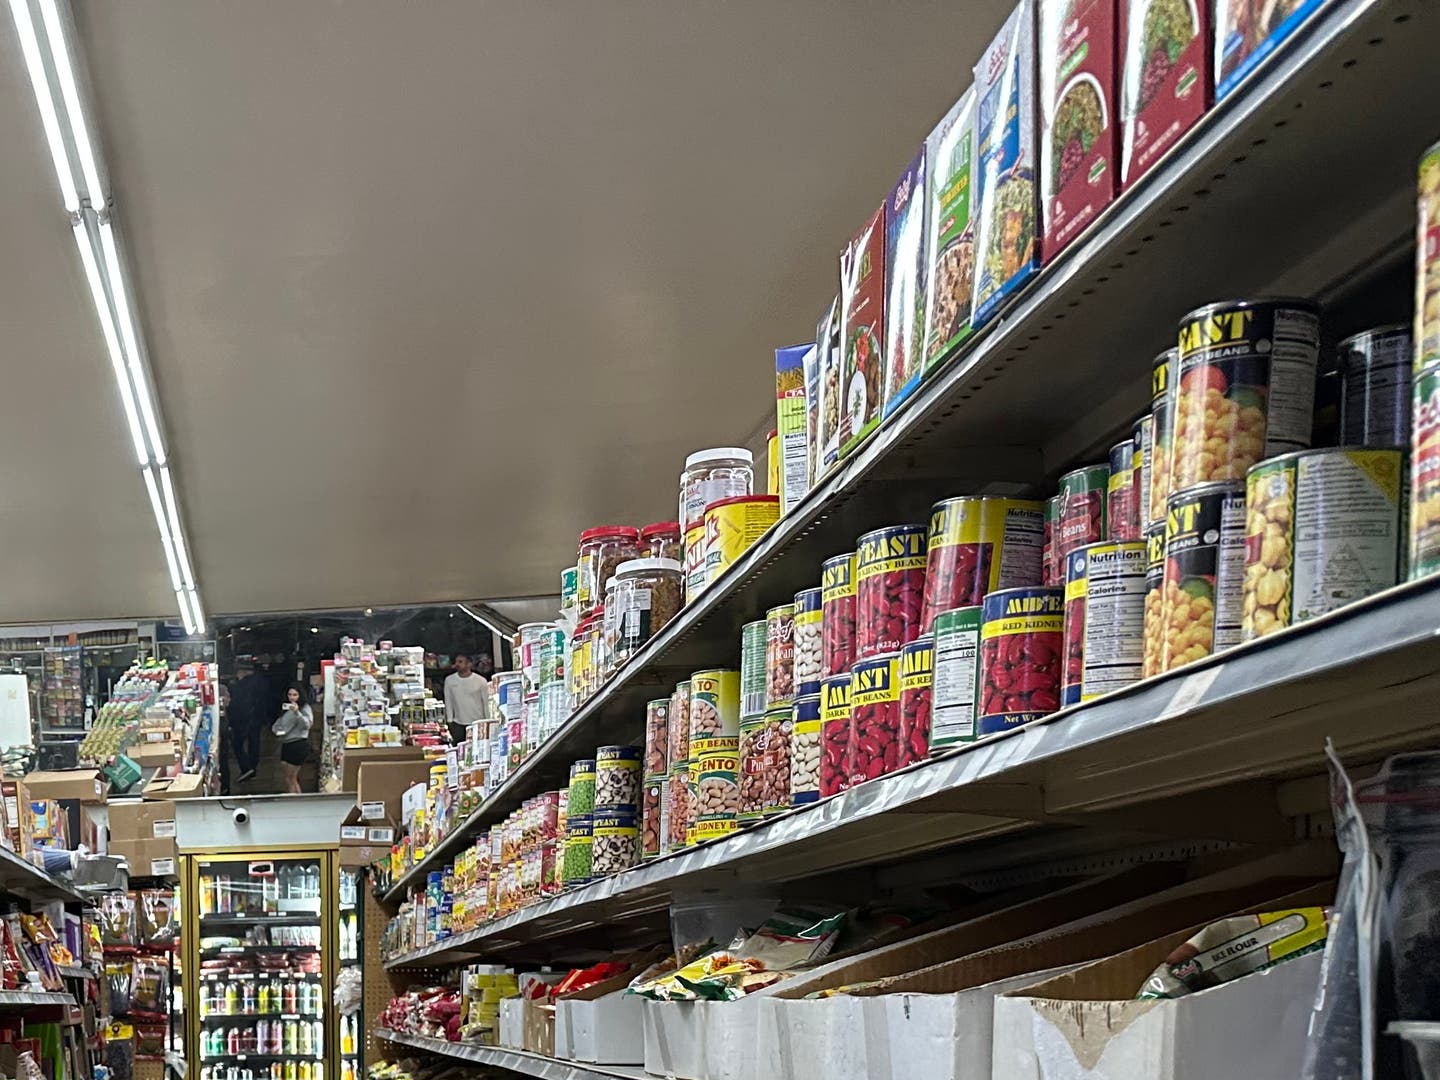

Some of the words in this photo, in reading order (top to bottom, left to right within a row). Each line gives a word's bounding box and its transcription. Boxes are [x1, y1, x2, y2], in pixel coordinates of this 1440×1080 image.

[1209, 345, 1250, 361] BEANS
[1089, 550, 1141, 564] Nutrition
[894, 557, 927, 570] BEANS
[1087, 585, 1127, 596] Calories
[1002, 620, 1021, 631] RED
[1024, 618, 1064, 629] KIDNEY
[863, 690, 892, 702] BEANS
[826, 709, 846, 719] DARK
[1003, 714, 1018, 723] Net
[707, 738, 740, 748] BEANS
[698, 759, 736, 771] CENTO
[1227, 937, 1260, 954] FLOUR
